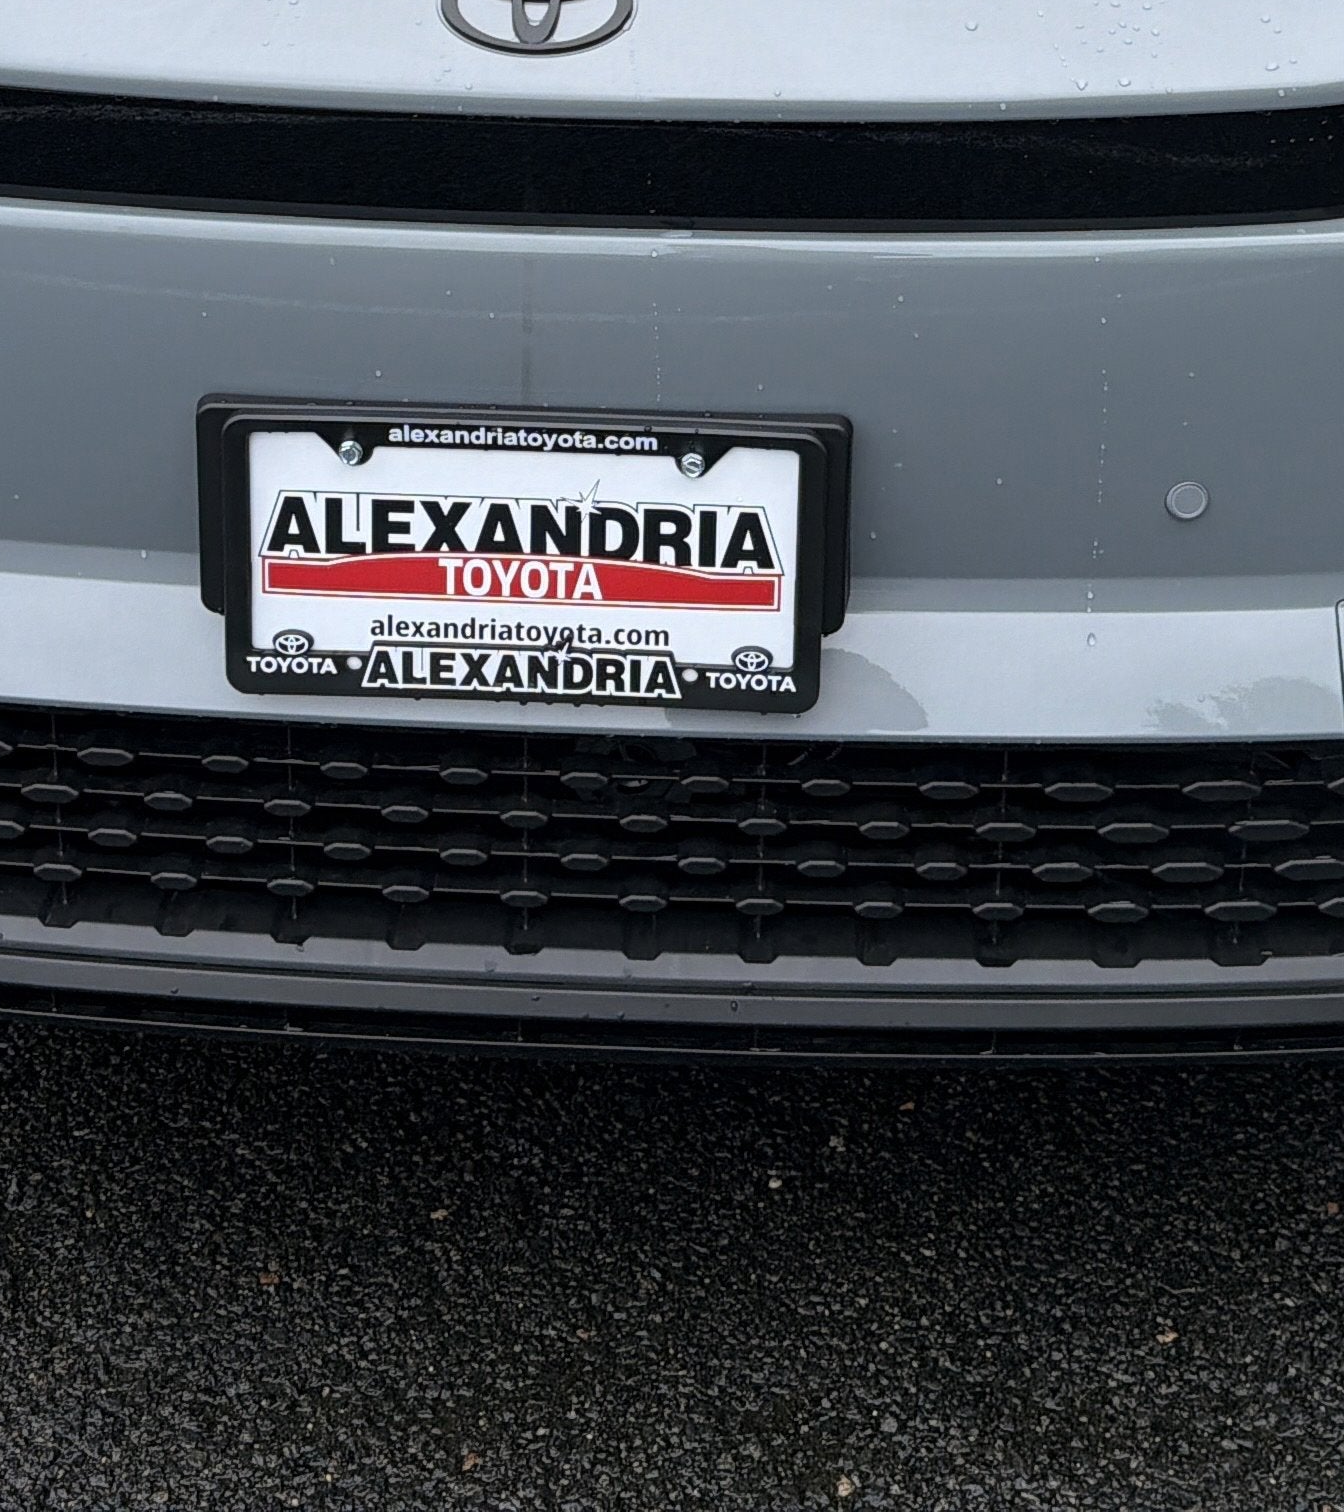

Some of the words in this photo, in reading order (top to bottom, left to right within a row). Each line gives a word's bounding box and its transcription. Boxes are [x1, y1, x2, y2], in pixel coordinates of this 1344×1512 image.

[388, 424, 658, 451] alexandriatoyota.com
[264, 493, 778, 572] ALEXANDRIA
[438, 558, 603, 601] TOYOTA
[370, 614, 670, 647] alexandriatoyota.com
[247, 656, 338, 676] TOYOTA
[362, 646, 681, 698] ALEXANDRIA
[706, 672, 797, 693] TOYOTA
